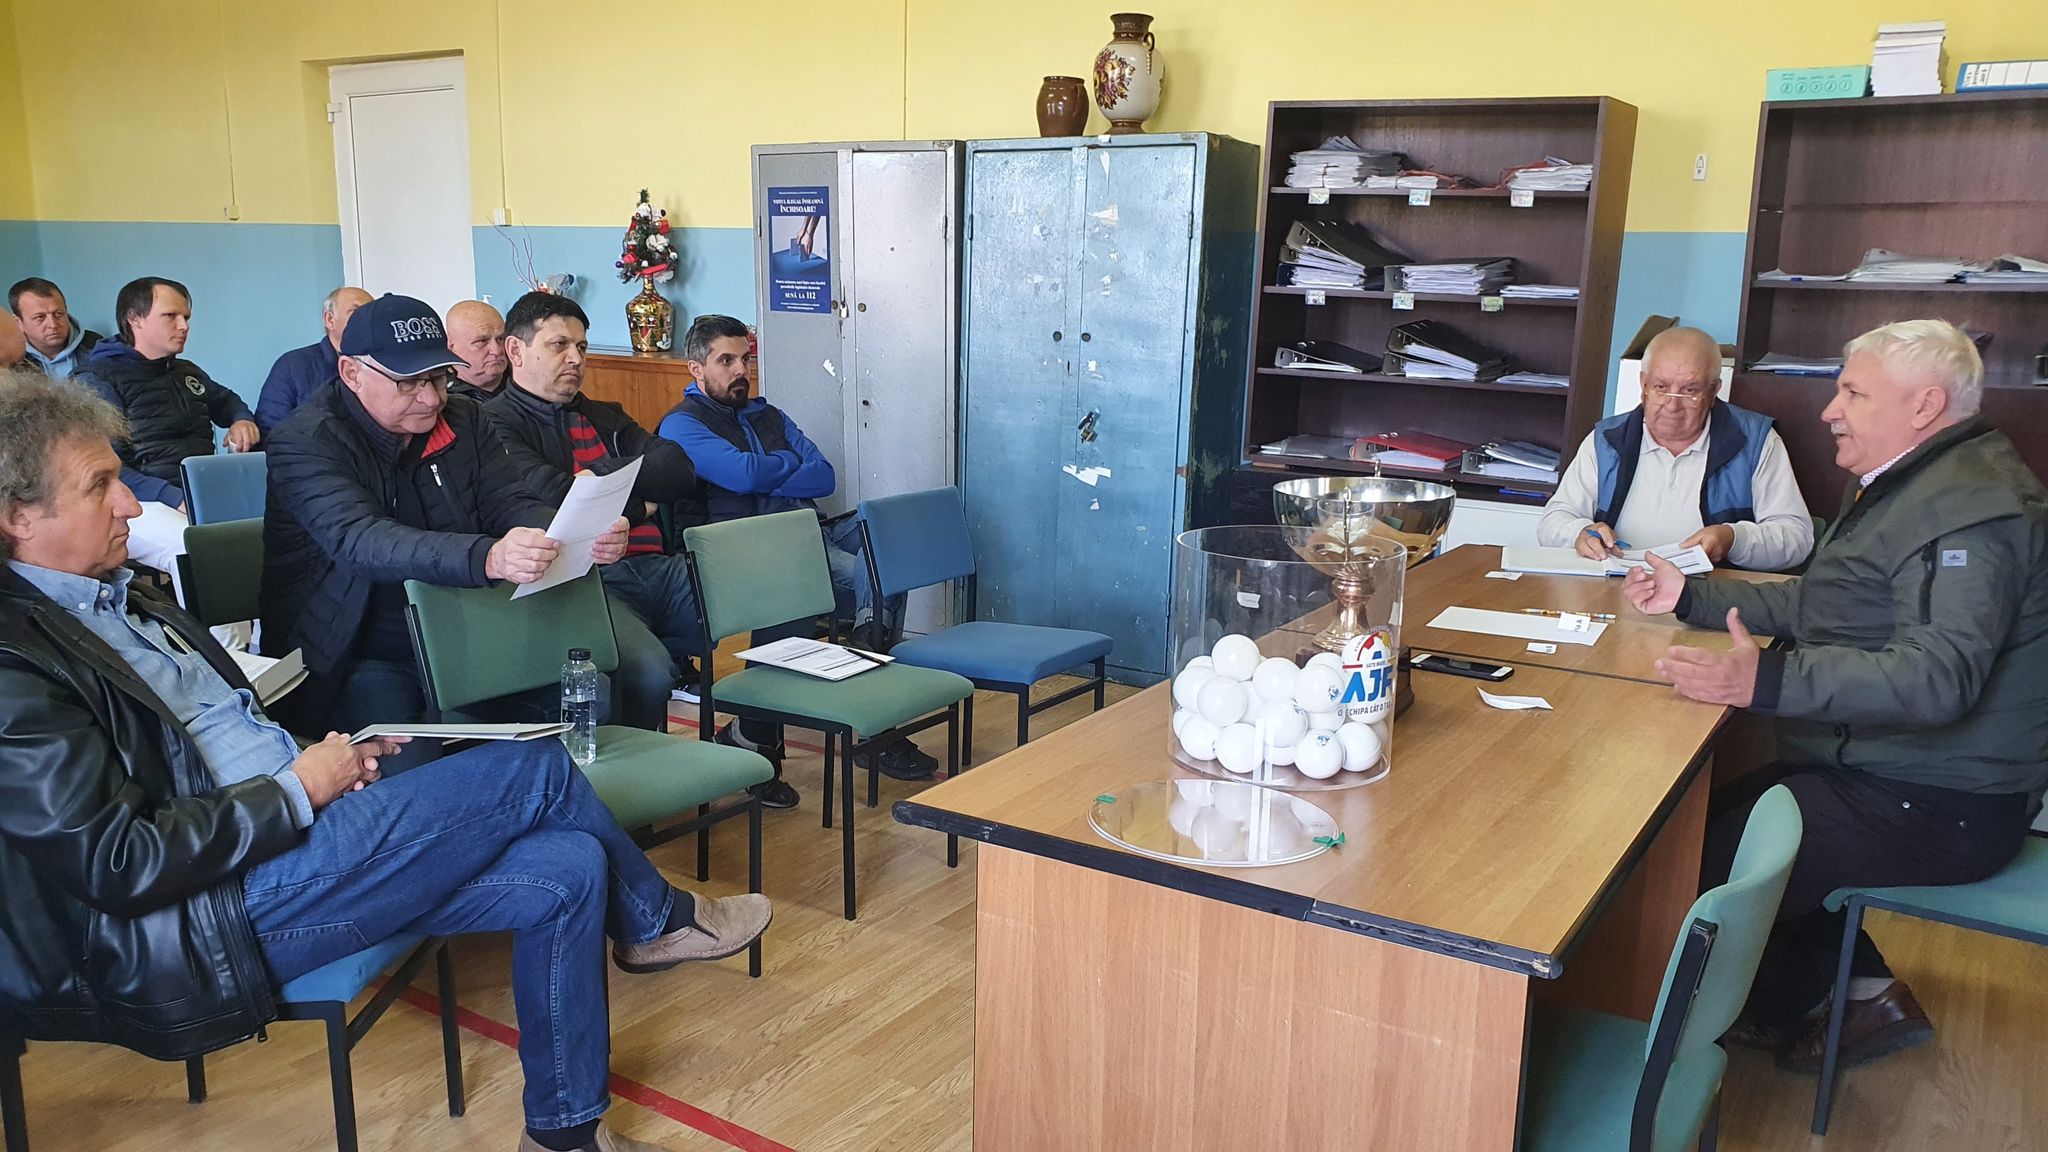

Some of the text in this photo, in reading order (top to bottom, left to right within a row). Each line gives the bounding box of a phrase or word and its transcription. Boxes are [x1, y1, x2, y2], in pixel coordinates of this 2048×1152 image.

[806, 291, 816, 299] 112
[391, 317, 440, 338] BOSS
[1340, 665, 1393, 703] AJF
